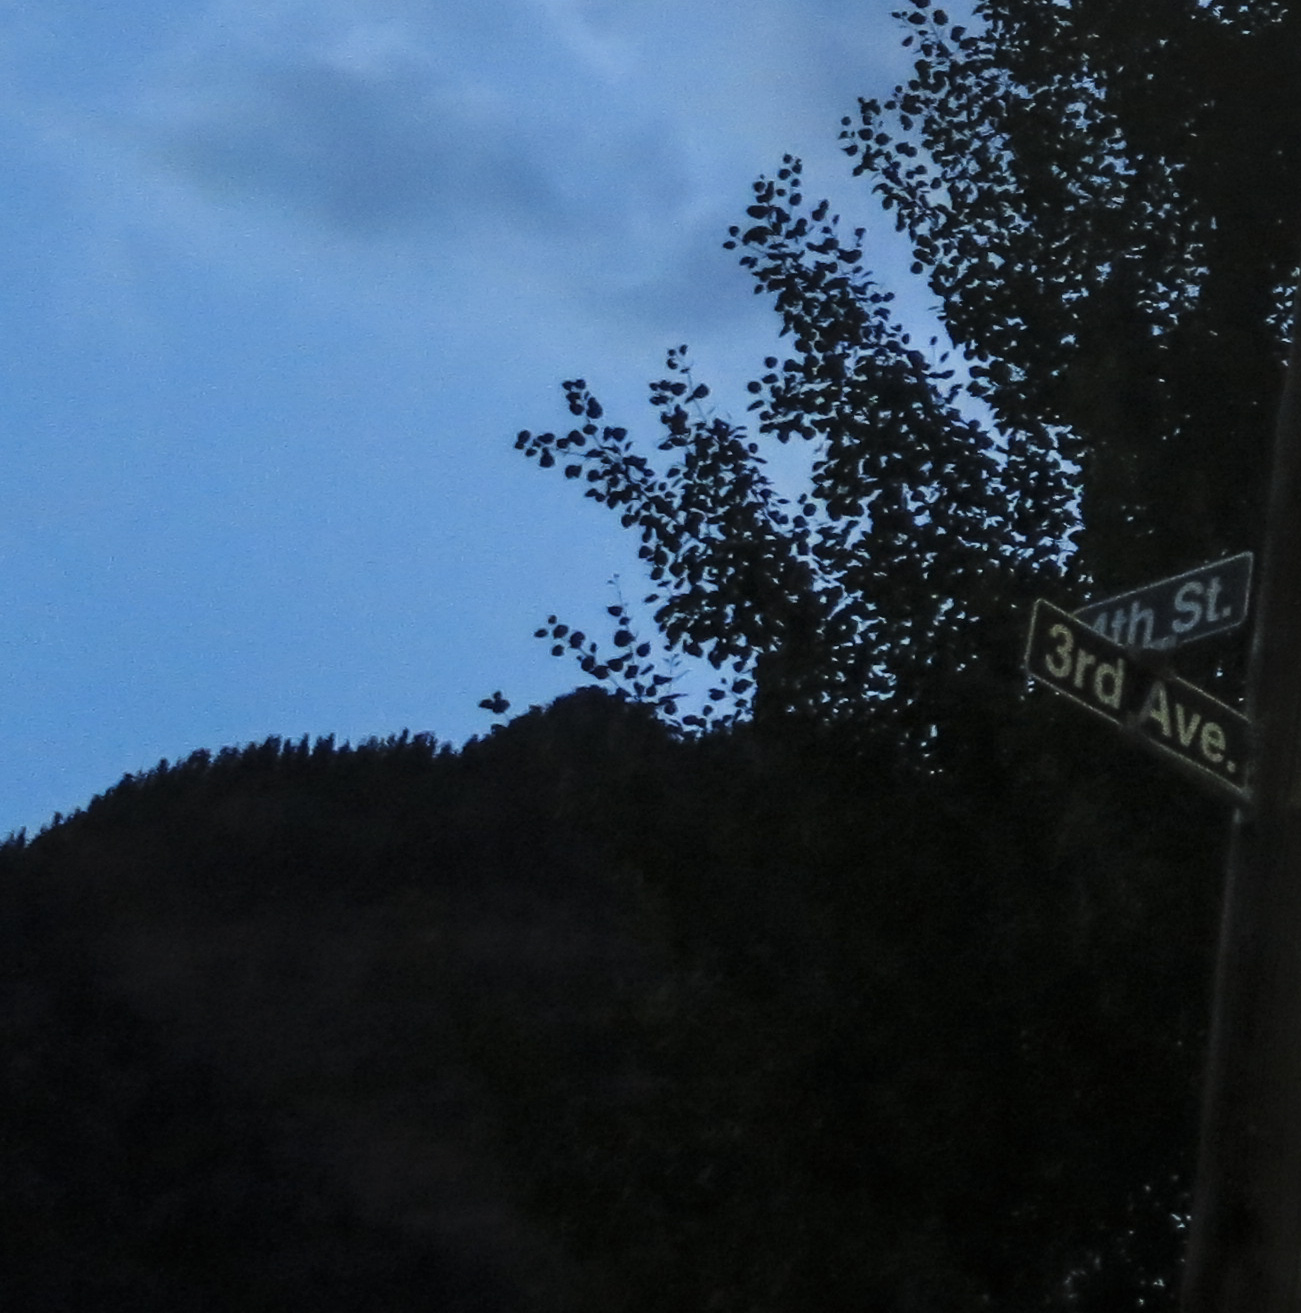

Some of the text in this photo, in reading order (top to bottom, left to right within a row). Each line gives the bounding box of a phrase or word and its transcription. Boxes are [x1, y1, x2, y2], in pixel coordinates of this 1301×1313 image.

[1172, 576, 1232, 632] St.
[1045, 623, 1237, 773] 3rd Ave.
